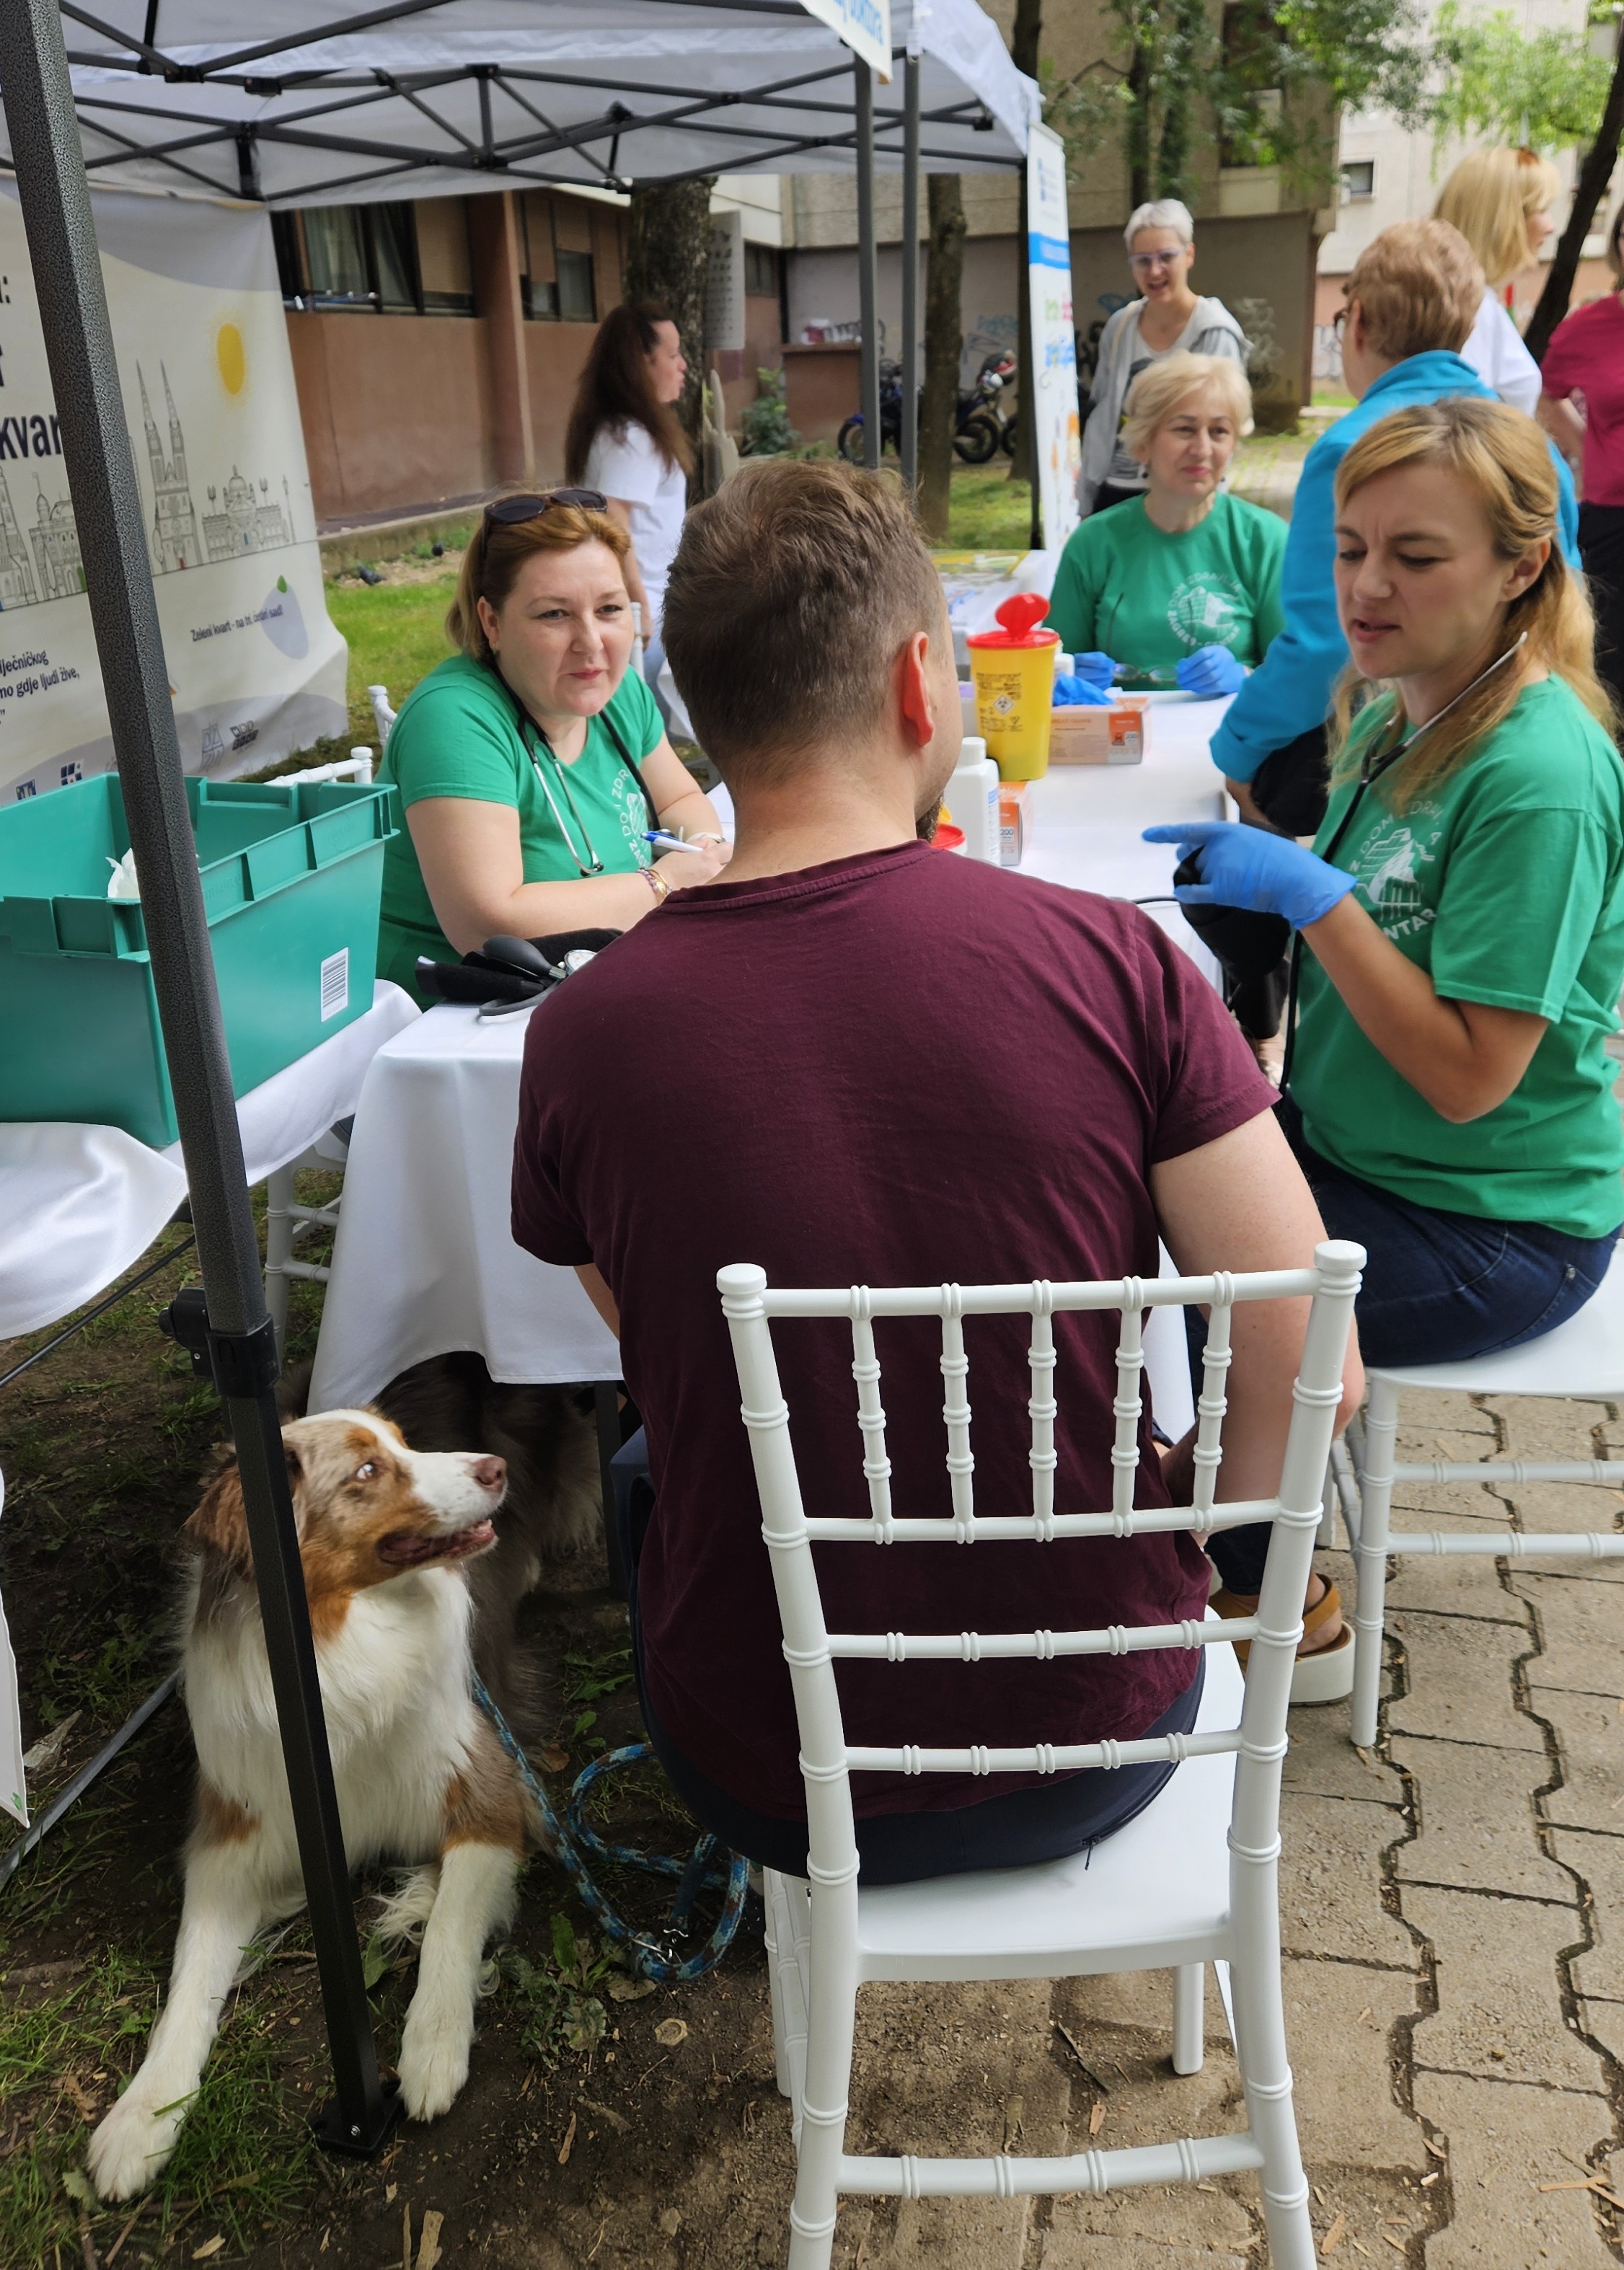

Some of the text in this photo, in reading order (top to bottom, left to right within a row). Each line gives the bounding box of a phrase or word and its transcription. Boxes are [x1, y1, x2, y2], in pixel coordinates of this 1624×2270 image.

[0, 413, 62, 461] kvar
[190, 624, 213, 642] Zeleni
[16, 676, 39, 698] gdje
[612, 769, 630, 799] ZDR
[1382, 908, 1438, 940] NTAR
